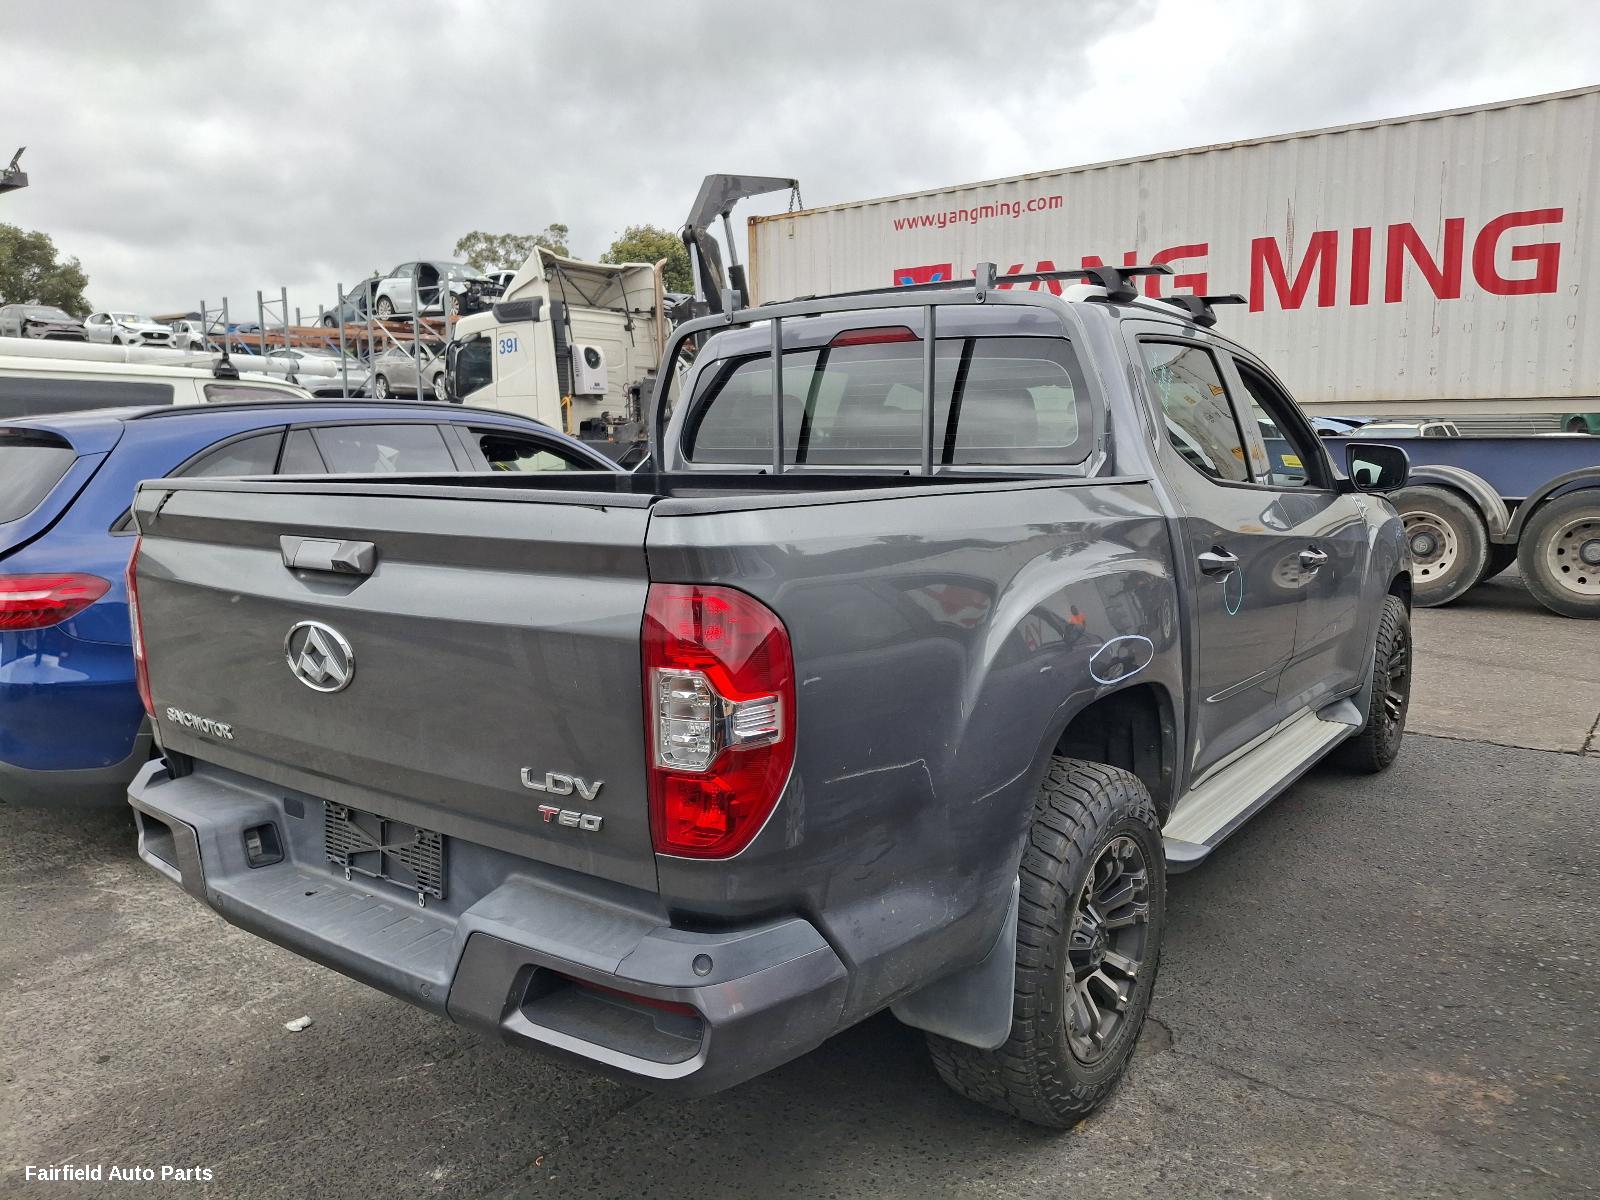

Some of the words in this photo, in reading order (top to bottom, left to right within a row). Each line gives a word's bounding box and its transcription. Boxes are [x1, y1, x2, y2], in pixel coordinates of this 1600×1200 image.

[893, 195, 1063, 231] www.yangming.com
[1249, 207, 1564, 312] MING
[499, 338, 518, 354] 391
[520, 767, 604, 801] LDV
[537, 804, 603, 832] T60
